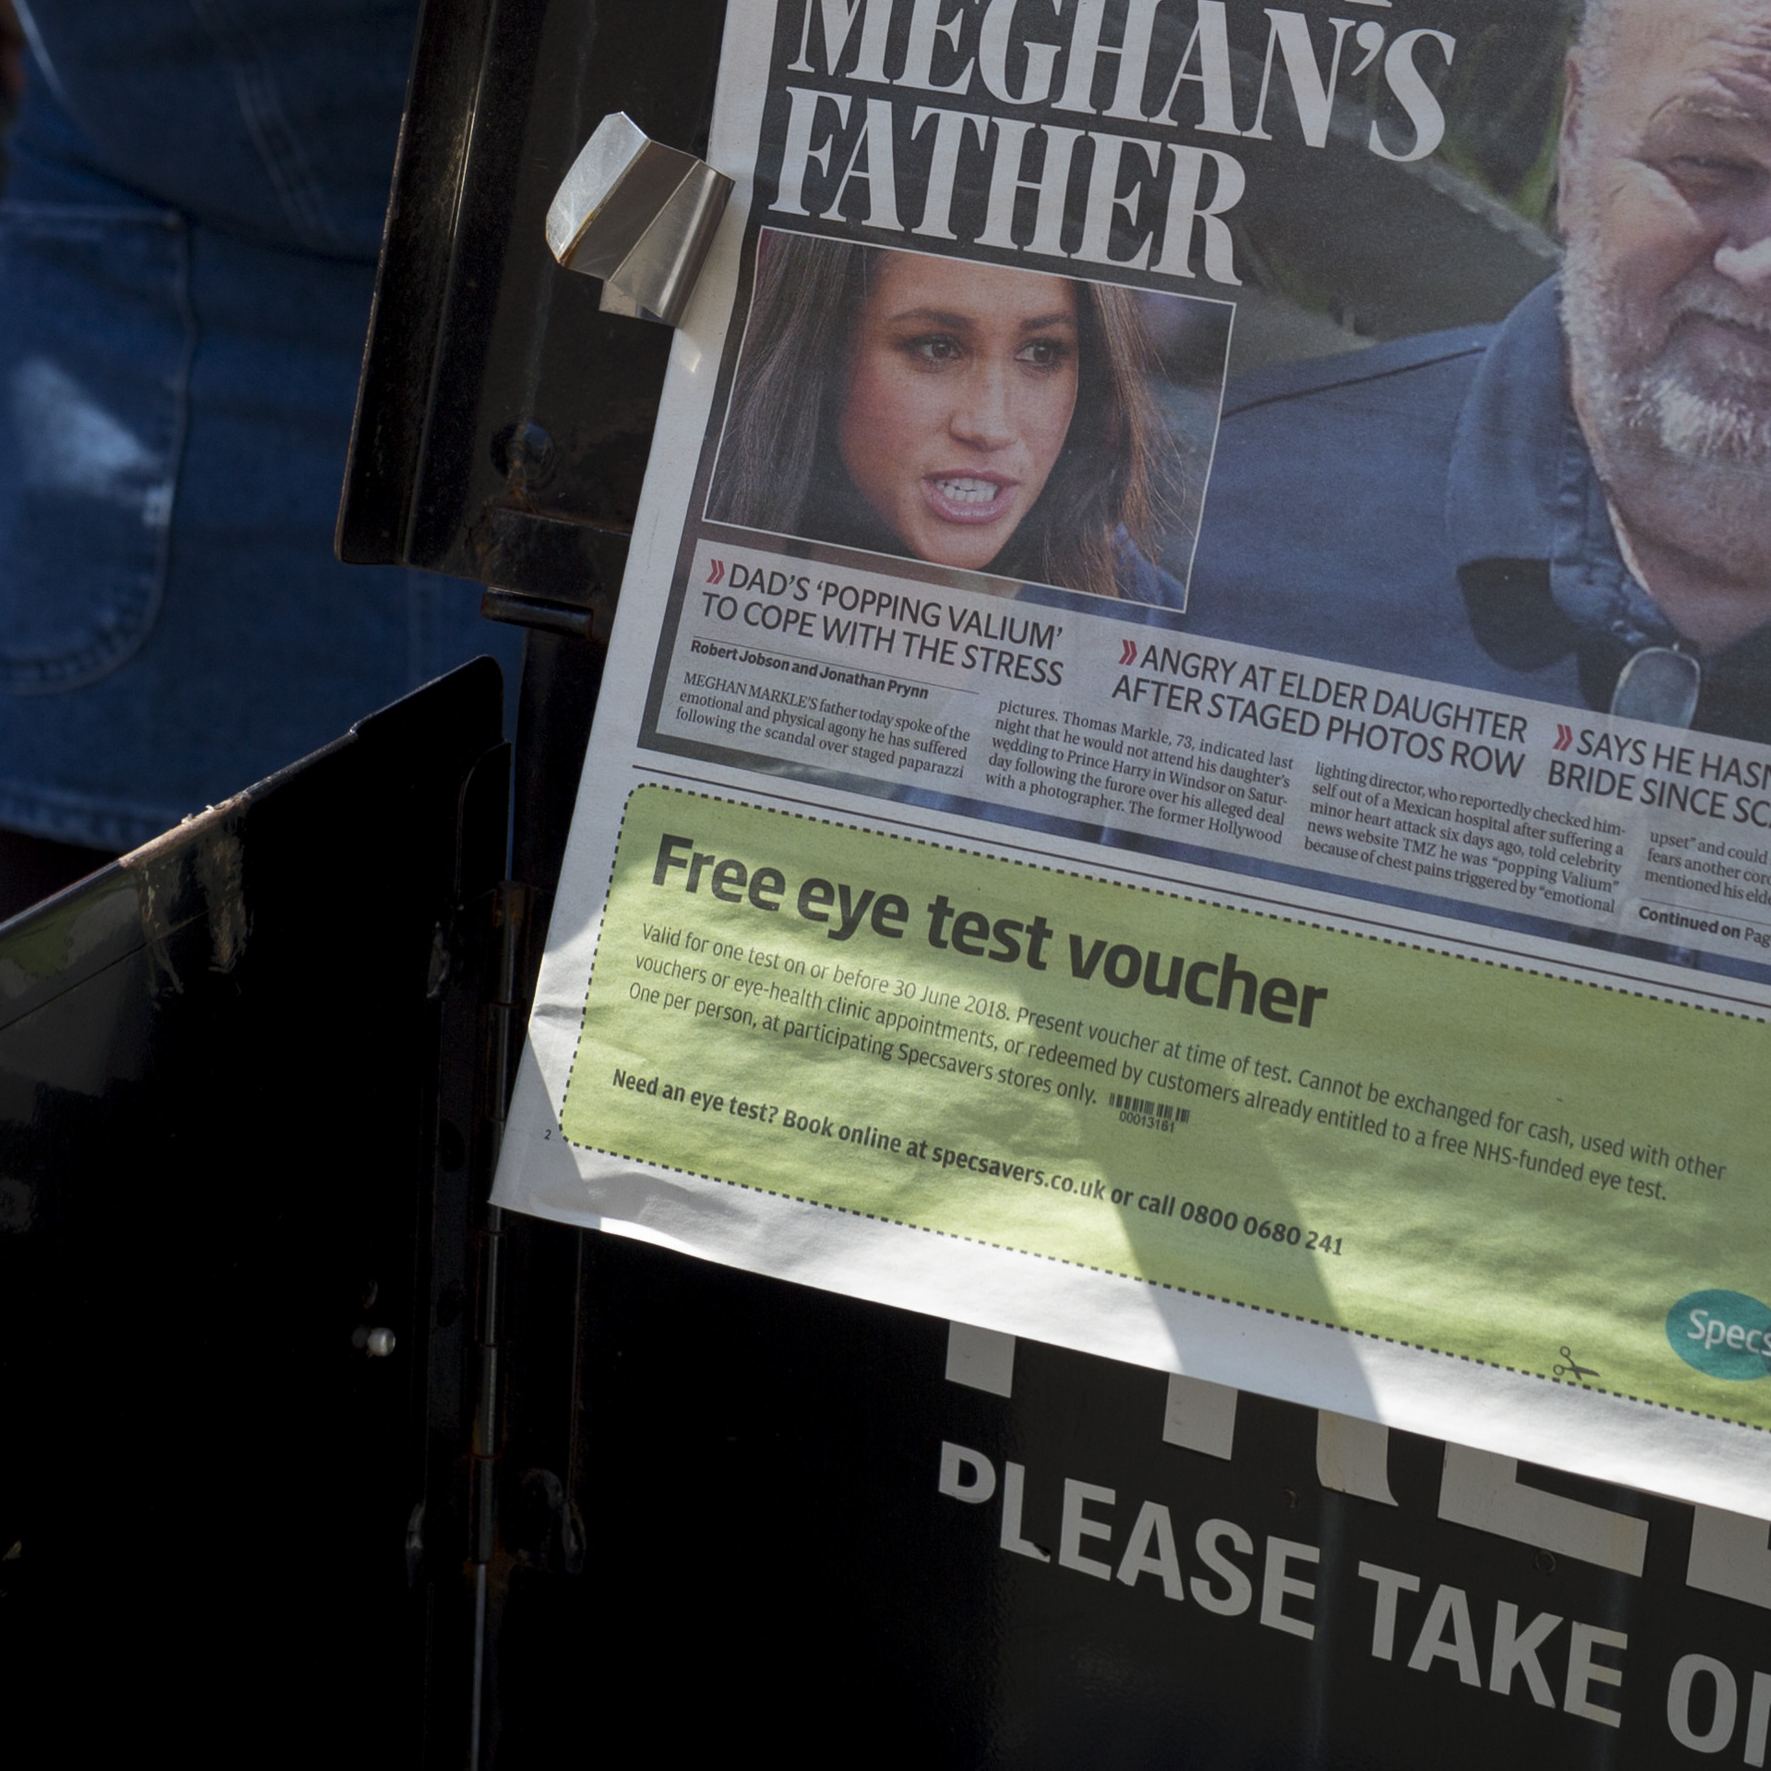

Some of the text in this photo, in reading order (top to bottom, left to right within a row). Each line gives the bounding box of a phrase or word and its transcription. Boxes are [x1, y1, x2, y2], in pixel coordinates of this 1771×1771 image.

[768, 86, 1246, 286] FATHER
[728, 563, 810, 601] DAD'S
[690, 639, 928, 699] Robert Jobson and Jonathan Prynn
[702, 591, 1063, 686] TO COPE WITH THE STRESS
[683, 671, 970, 741] MEGHAN MARKLE'S father today spoke of the
[1111, 674, 1525, 778] AFTER STAGED PHOTOS ROW
[1139, 645, 1527, 743] ANGRY AT ELDER DAUGHTER
[1548, 759, 1635, 801] BRIDE
[1640, 778, 1728, 819] SINCE
[1576, 729, 1647, 765] SAYS
[1652, 743, 1694, 776] HE
[653, 833, 1329, 1028] Free eye test voucher
[1638, 905, 1719, 934] Continued
[1721, 925, 1740, 939] on
[629, 982, 1096, 1106] One per person, at participating Specsavers stores only.
[636, 955, 1666, 1200] vouchers or eye-health clinic appointments, or redeemed by customers already entitled to a free NHS-funded eye test.
[643, 923, 1727, 1180] Valid for one test on or before 30 June 2018. Present voucher at time of test. Cannot be exchanged for cash, used with other
[613, 1068, 1342, 1255] Need an eye test? Book online at specsavers.co.uk or call 0800 0680 241
[938, 1440, 1320, 1640] PLEASE
[1355, 1561, 1629, 1728] TAKE
